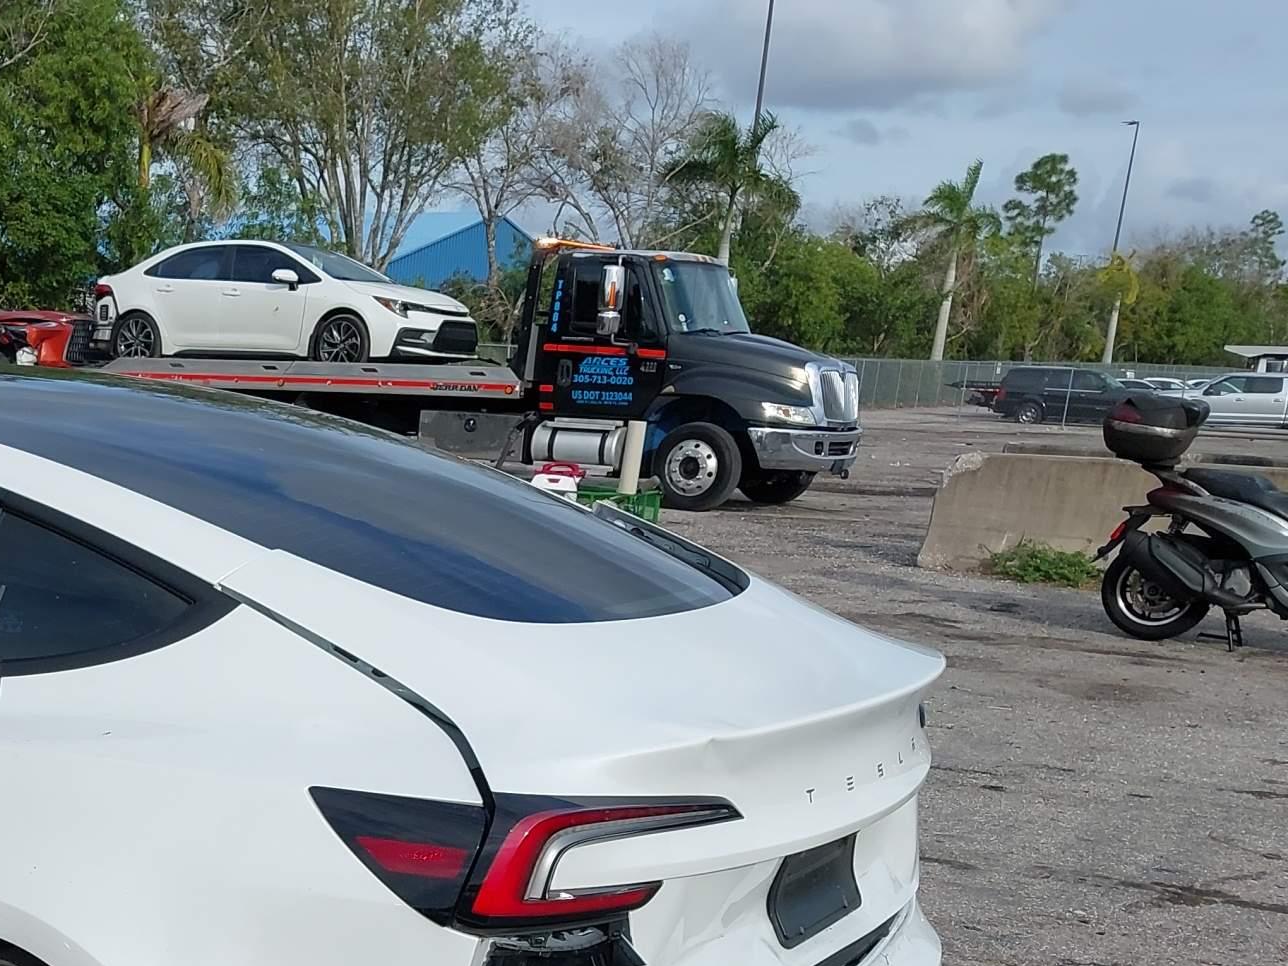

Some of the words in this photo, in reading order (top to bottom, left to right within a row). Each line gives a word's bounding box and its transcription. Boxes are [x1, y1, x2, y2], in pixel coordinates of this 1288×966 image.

[573, 374, 634, 385] 305-713-0020
[572, 390, 582, 400] US
[583, 390, 600, 400] DOT
[806, 736, 916, 803] TESLA
